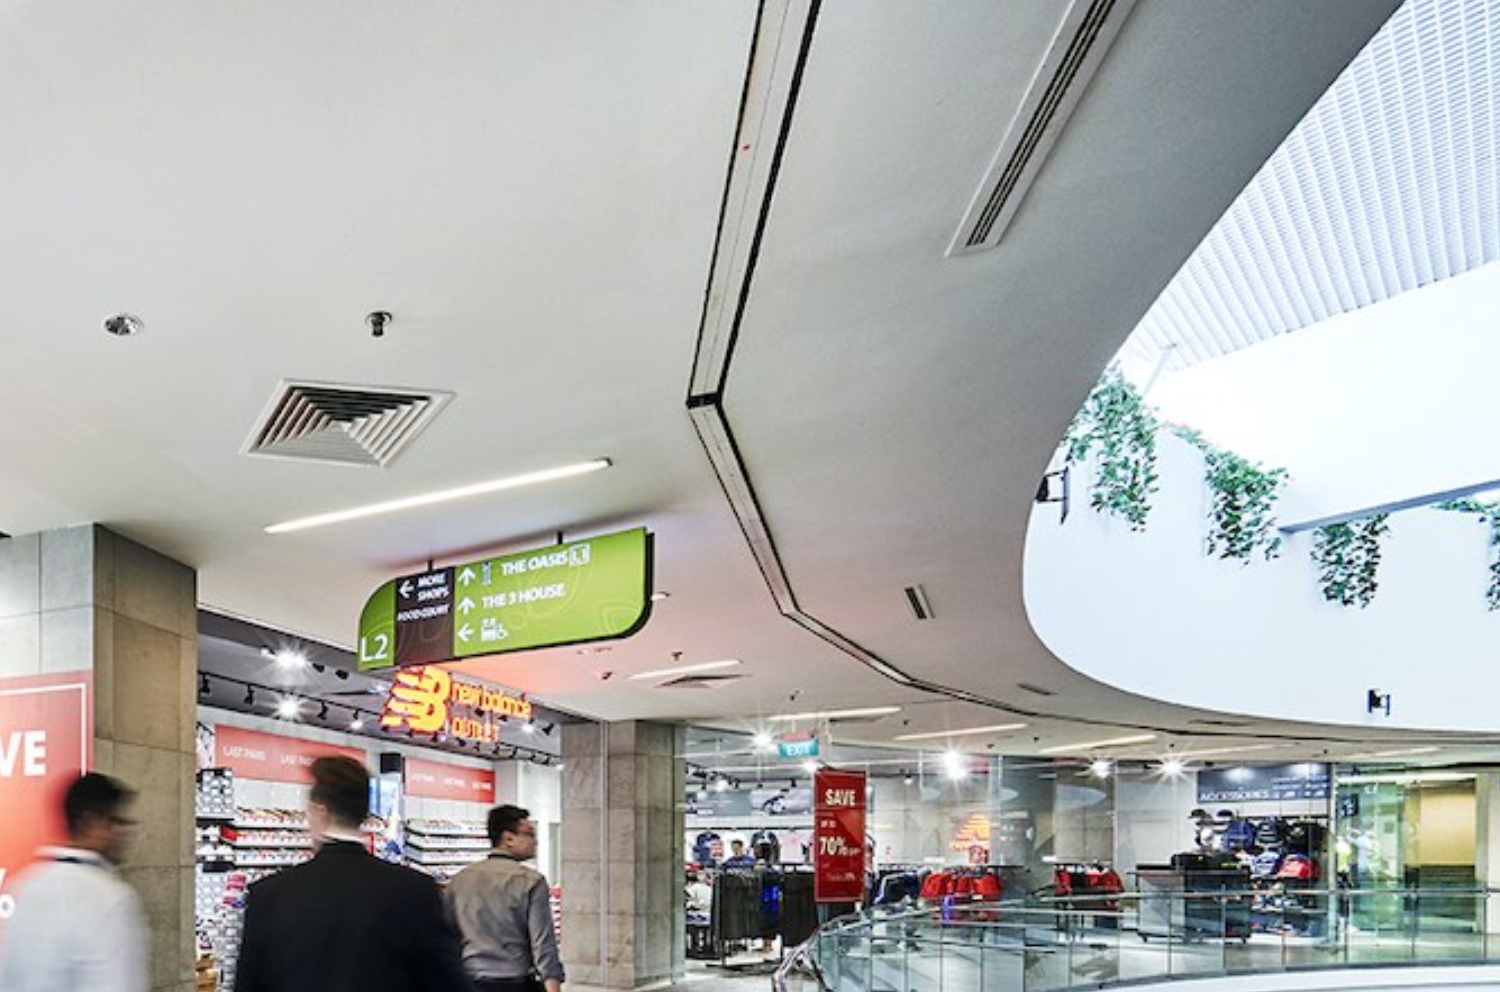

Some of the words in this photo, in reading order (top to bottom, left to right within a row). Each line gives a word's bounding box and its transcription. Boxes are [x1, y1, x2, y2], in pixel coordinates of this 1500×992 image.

[501, 558, 527, 576] THE
[482, 592, 506, 608] THE
[360, 634, 388, 661] L2
[452, 717, 500, 741] OUTLET
[825, 789, 856, 806] SAVE
